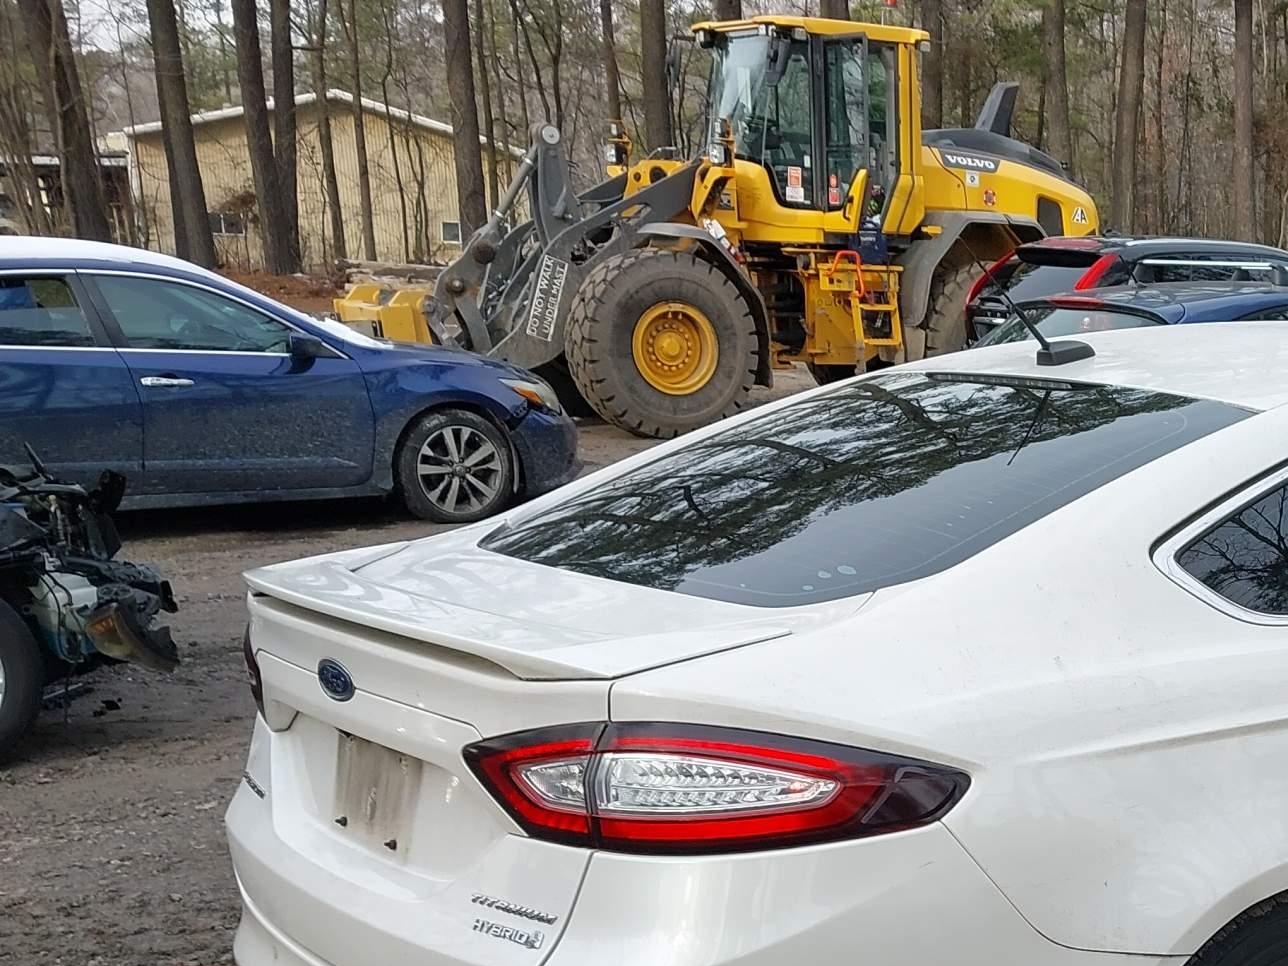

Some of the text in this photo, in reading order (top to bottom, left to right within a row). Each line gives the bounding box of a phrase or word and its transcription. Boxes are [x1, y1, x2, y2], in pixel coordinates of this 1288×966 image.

[944, 154, 995, 169] VOLVO
[528, 257, 555, 337] DO NOT WALK
[541, 264, 566, 334] UNDER MAST
[472, 918, 530, 947] HYBRID
